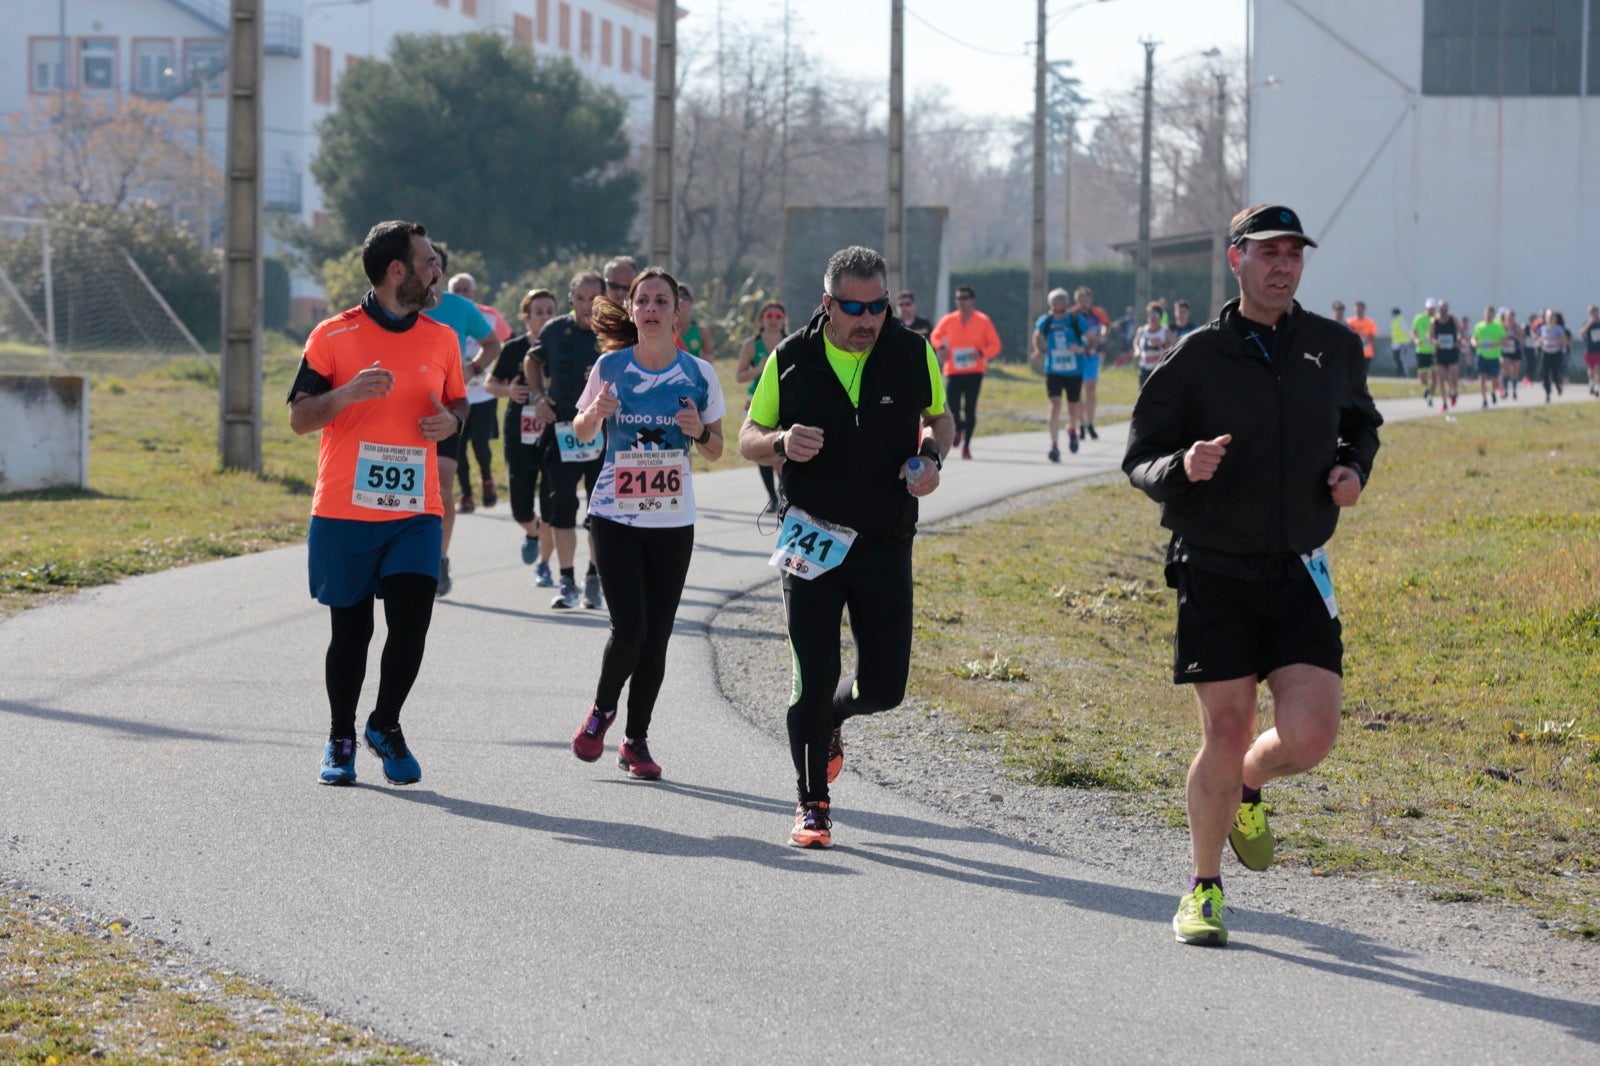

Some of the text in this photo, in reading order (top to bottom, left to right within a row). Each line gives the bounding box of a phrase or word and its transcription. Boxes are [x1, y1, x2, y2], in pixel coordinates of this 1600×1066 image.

[619, 414, 652, 424] TODO
[367, 465, 416, 491] 593
[619, 469, 680, 494] 2146
[785, 523, 833, 562] 241
